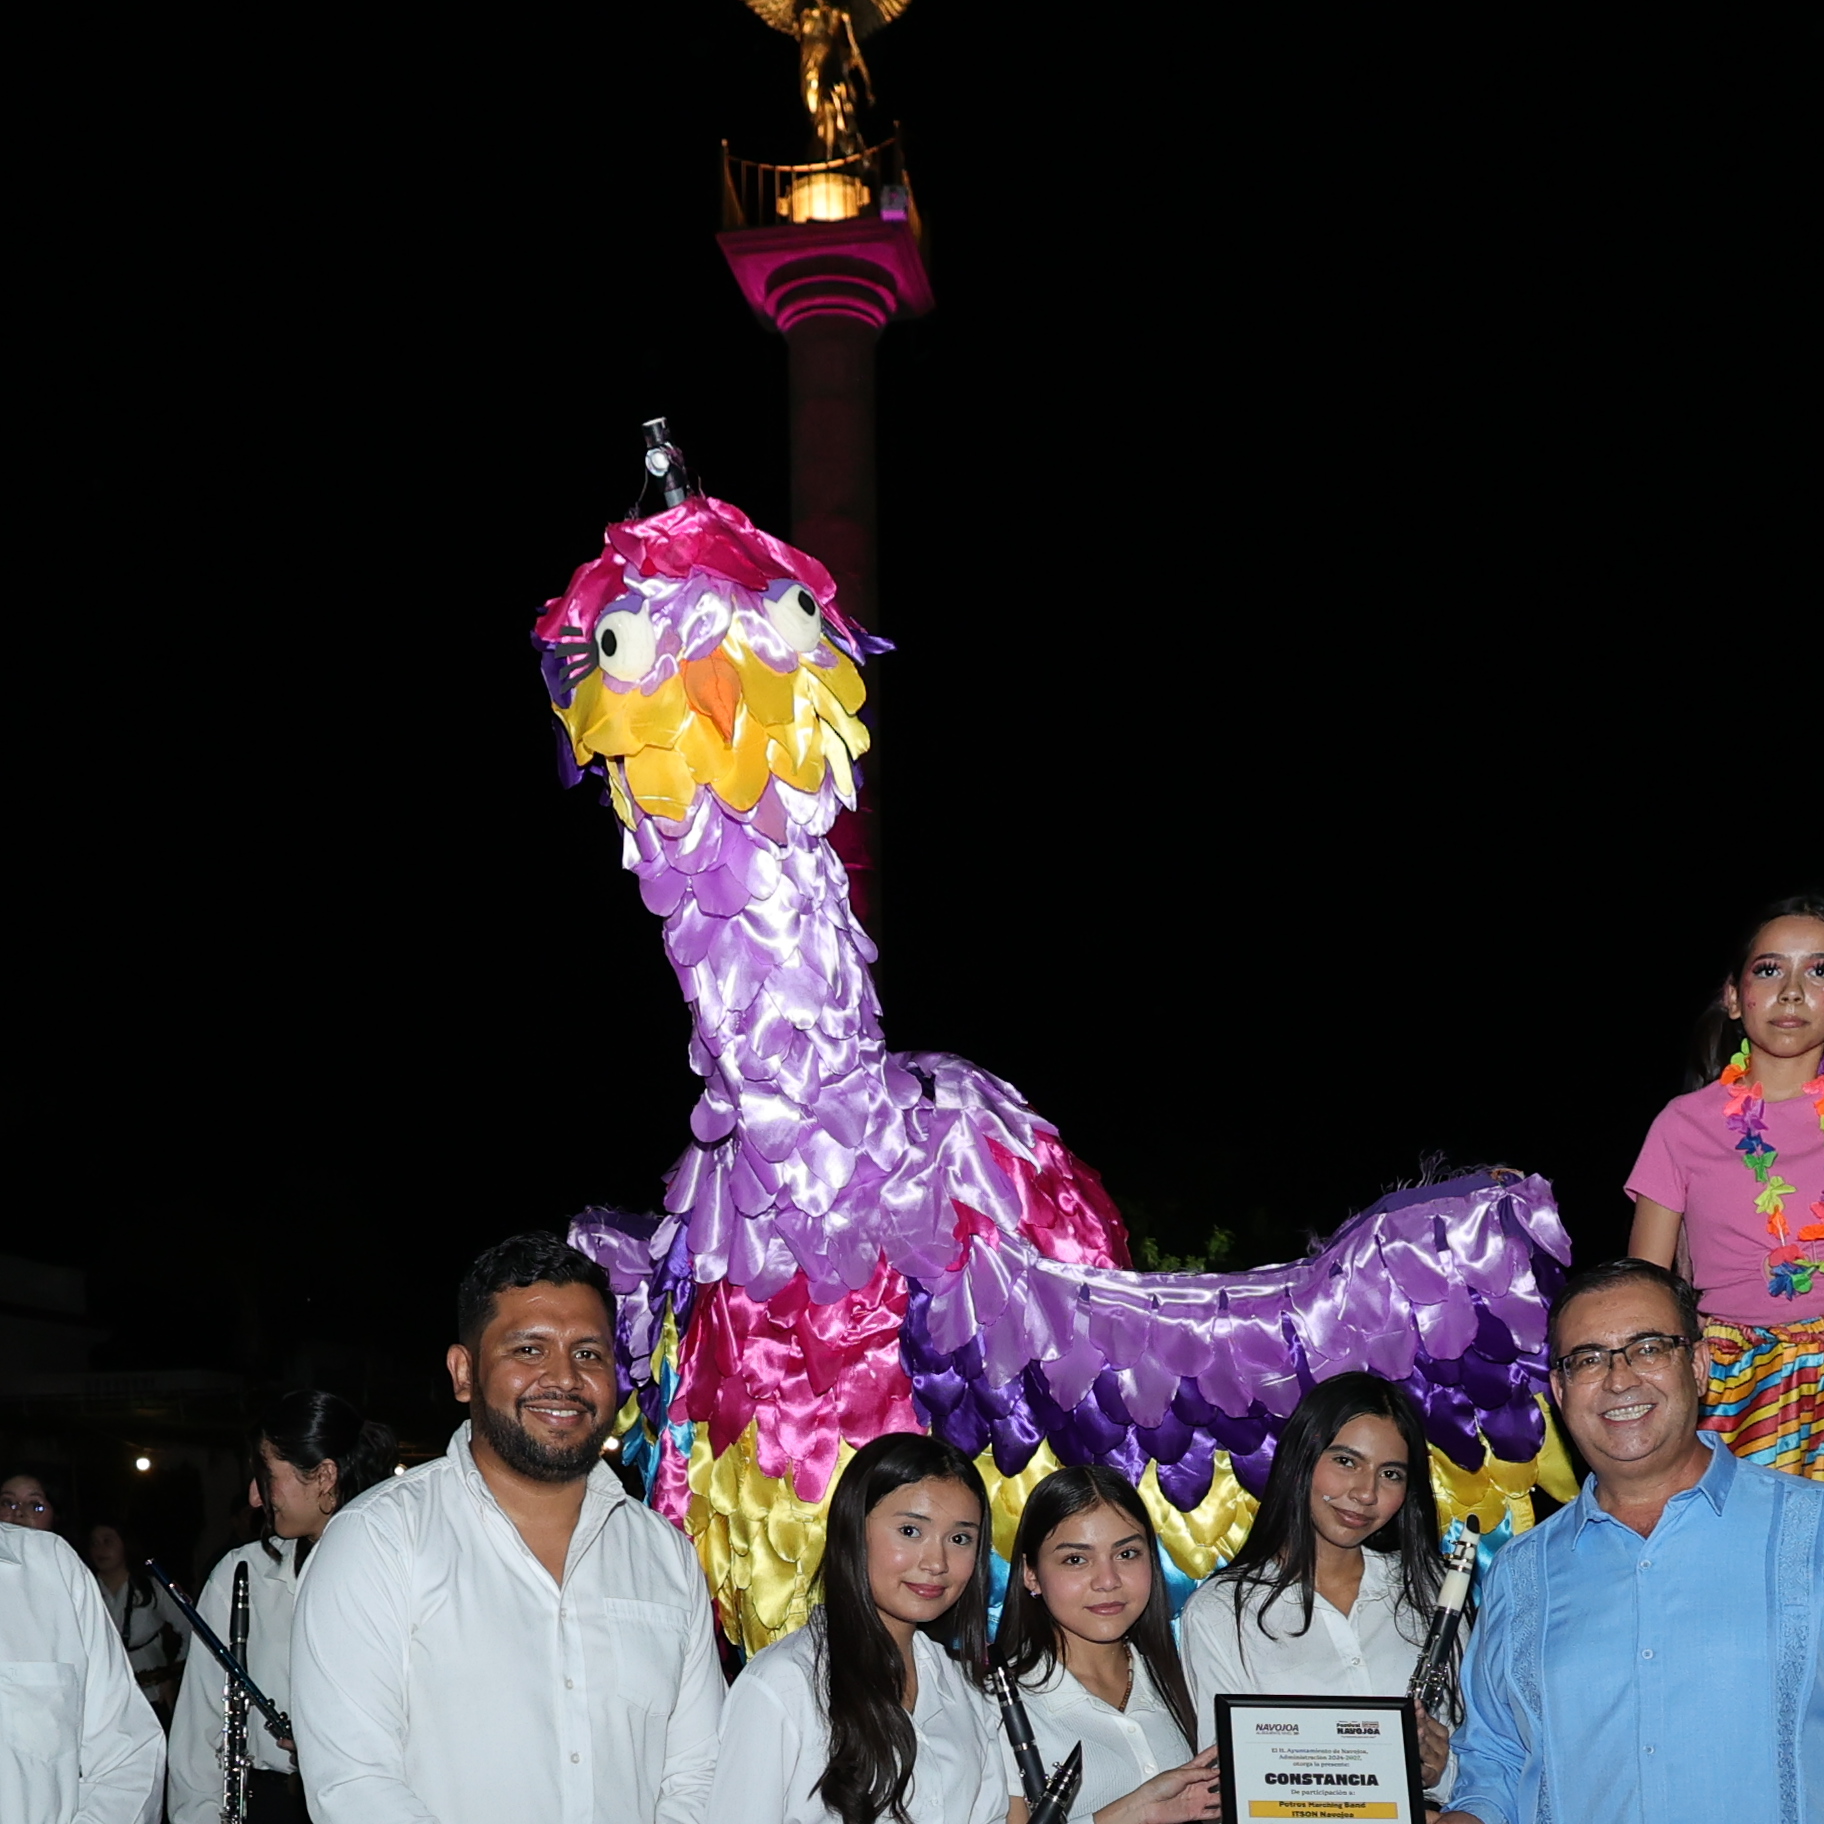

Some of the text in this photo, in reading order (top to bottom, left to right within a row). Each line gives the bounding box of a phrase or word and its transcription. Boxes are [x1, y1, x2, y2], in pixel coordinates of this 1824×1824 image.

[1255, 1723, 1300, 1732] NAVOJOA
[1337, 1727, 1381, 1735] NAVOJOA
[1264, 1772, 1380, 1786] CONSTANCIA
[1301, 1789, 1347, 1797] participación
[1278, 1800, 1306, 1808] Potros
[1308, 1801, 1343, 1809] Marching
[1320, 1811, 1355, 1819] Navojoa
